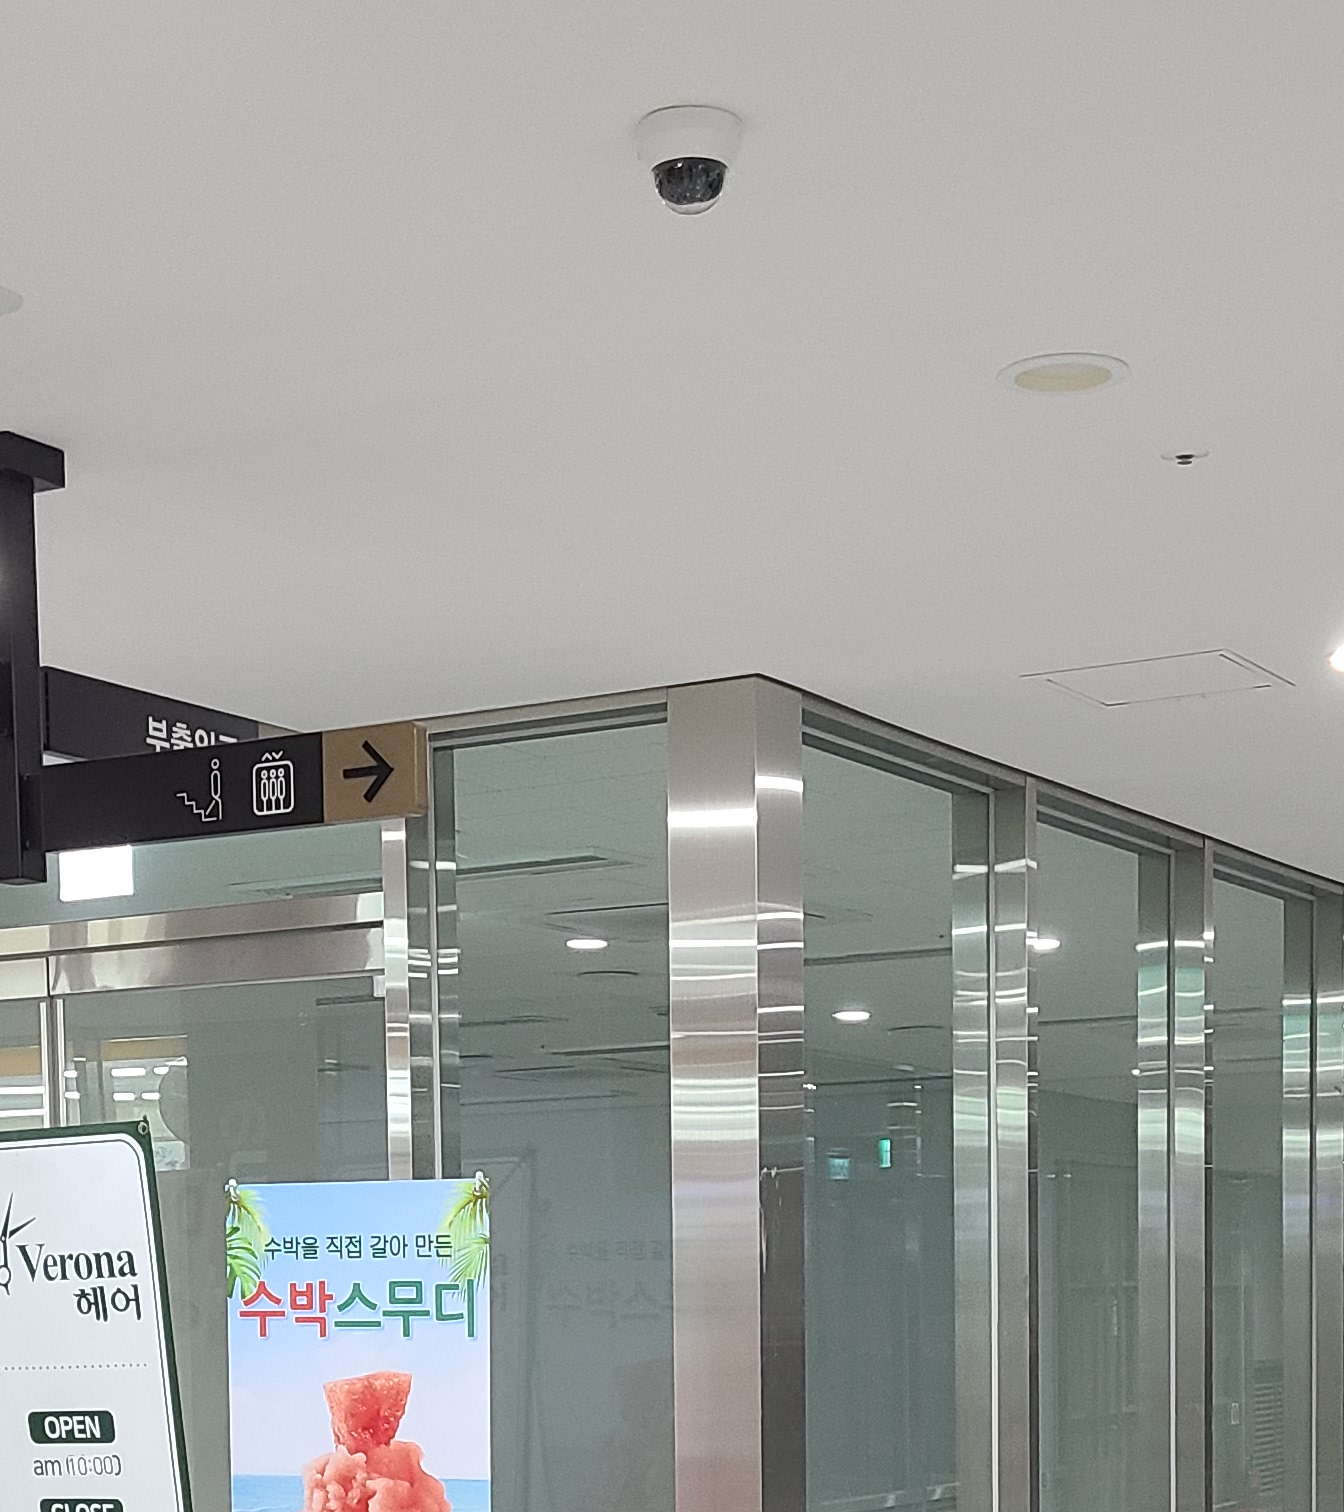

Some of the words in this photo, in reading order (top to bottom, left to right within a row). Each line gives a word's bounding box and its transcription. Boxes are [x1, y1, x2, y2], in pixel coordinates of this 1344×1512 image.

[15, 1243, 138, 1283] Verona
[264, 1236, 319, 1260] 수박을
[325, 1235, 362, 1259] 직접
[369, 1234, 408, 1259] 갈아
[415, 1234, 453, 1258] 만든
[73, 1284, 142, 1322] 헤어
[239, 1278, 475, 1338] 수박스무디
[44, 1415, 101, 1439] OPEN
[34, 1459, 62, 1476] am
